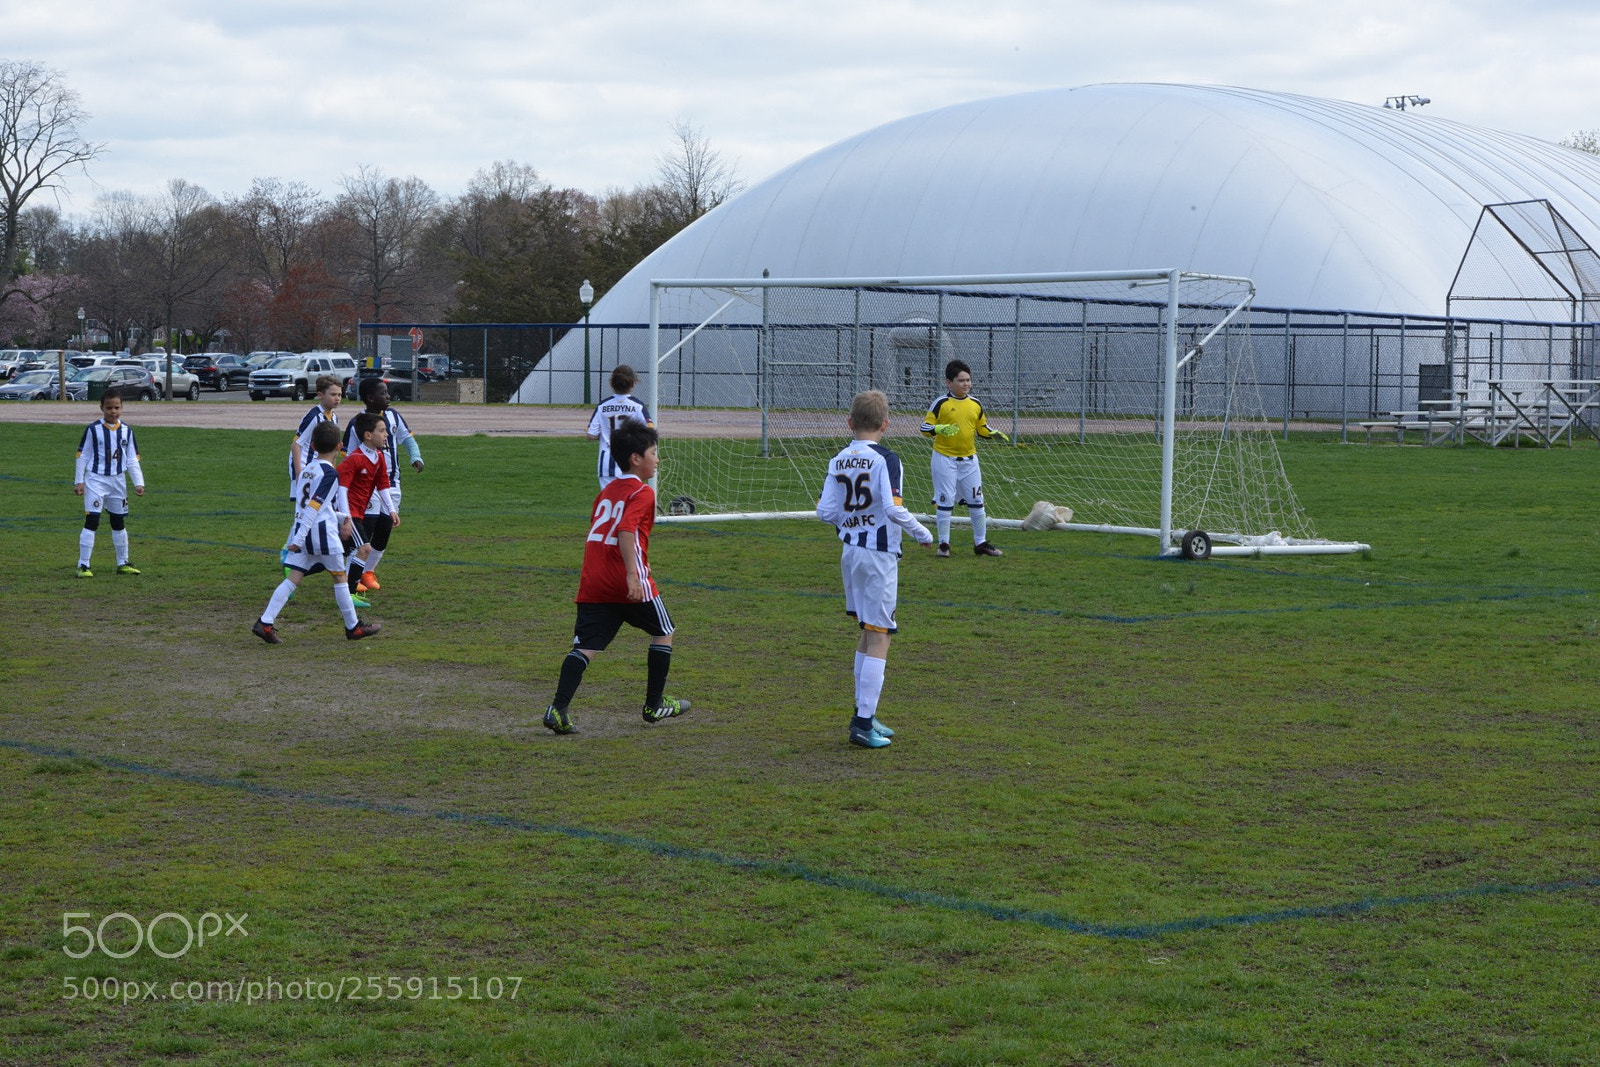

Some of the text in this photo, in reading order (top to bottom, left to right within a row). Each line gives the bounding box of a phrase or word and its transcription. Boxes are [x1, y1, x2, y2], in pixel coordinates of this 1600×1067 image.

[602, 404, 636, 413] BERDYNA
[835, 472, 873, 513] 26
[972, 486, 982, 499] 14
[586, 498, 625, 546] 22
[861, 514, 876, 527] FC
